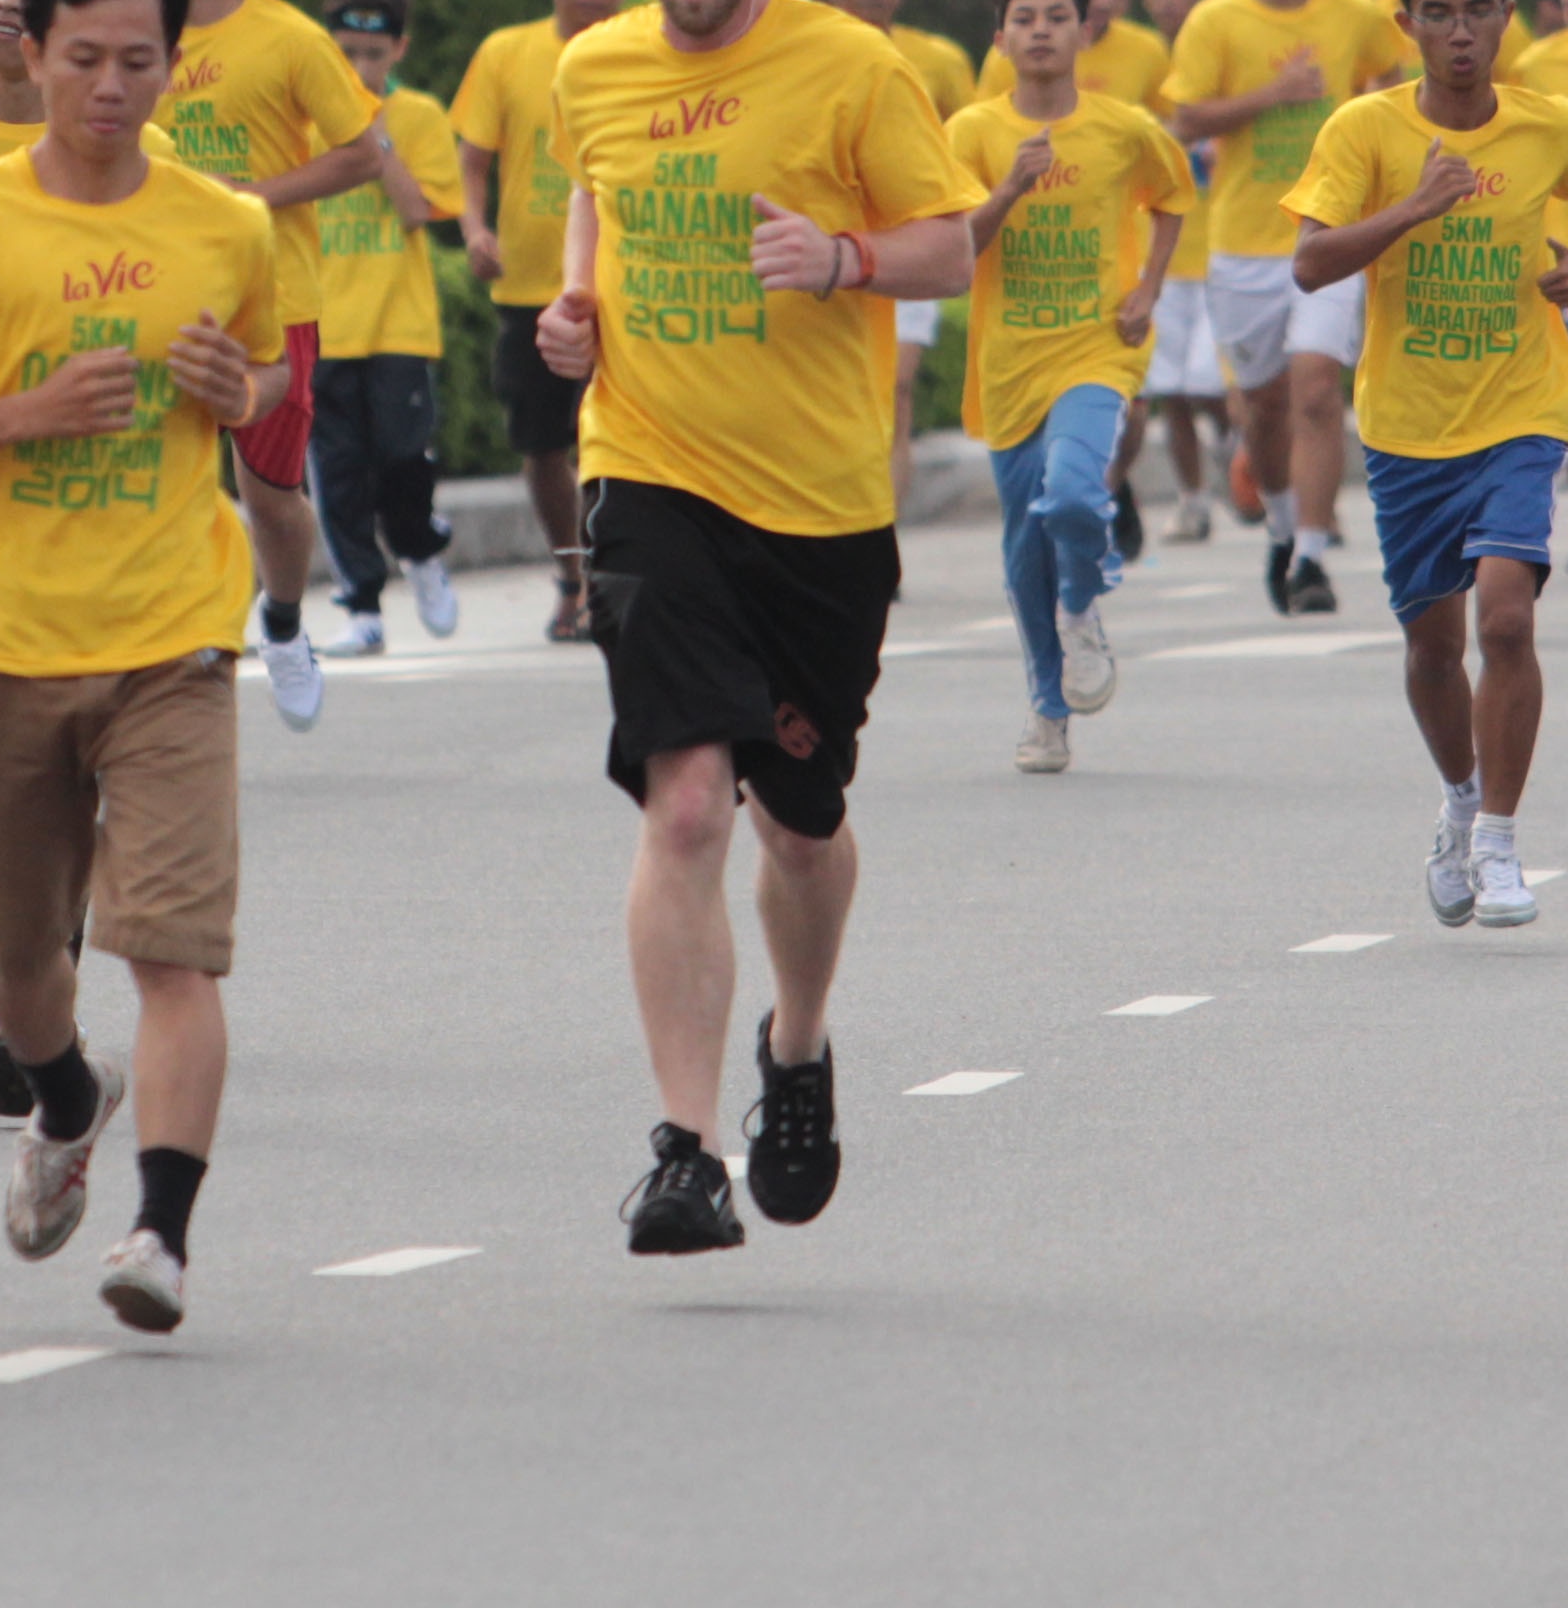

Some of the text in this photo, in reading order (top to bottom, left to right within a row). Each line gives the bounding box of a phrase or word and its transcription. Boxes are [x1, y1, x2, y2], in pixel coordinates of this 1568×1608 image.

[175, 101, 214, 124] 5KM
[170, 123, 248, 157] ANANG
[654, 152, 717, 187] 5KM
[1027, 203, 1072, 229] 5KM
[1441, 215, 1493, 243] 5KM
[617, 236, 753, 265] INTERNATIONA
[1001, 226, 1102, 260] DANANG
[1407, 240, 1522, 282] DANANG
[621, 266, 766, 307] MARATHON
[1002, 276, 1101, 303] MARATHON
[1405, 278, 1517, 305] INTERNATIONAL
[625, 303, 767, 344] 2014
[1002, 302, 1102, 329] 2014
[1404, 300, 1518, 333] MARATHON
[71, 314, 138, 352] 5KM
[1403, 329, 1520, 363] 2014
[10, 468, 159, 514] 2014
